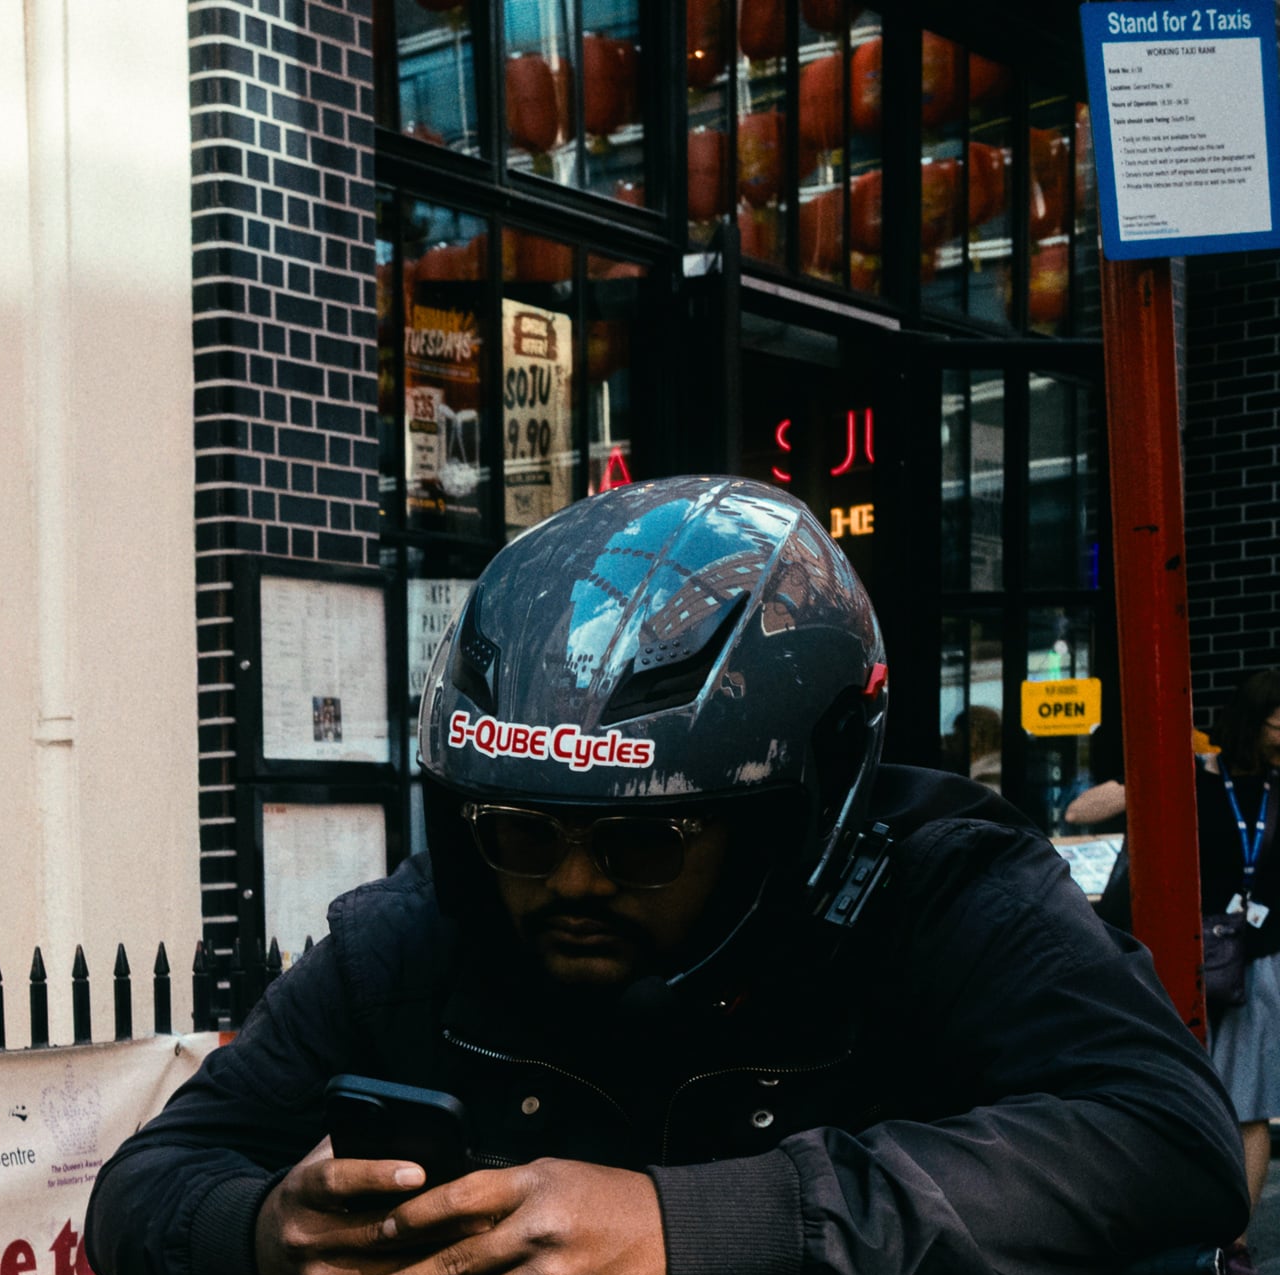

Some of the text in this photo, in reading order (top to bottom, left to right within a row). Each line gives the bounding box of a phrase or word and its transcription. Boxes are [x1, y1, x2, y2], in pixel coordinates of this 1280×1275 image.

[1107, 9, 1251, 34] Stand for 2 Taxis
[1146, 46, 1216, 56] WORKING TAXI RANK
[404, 326, 472, 362] TUESDAYS
[505, 365, 551, 410] SOJU
[508, 418, 551, 460] 9.90
[1037, 701, 1085, 719] OPEN
[450, 714, 650, 767] S-QUBE Cycles
[51, 1164, 61, 1173] The
